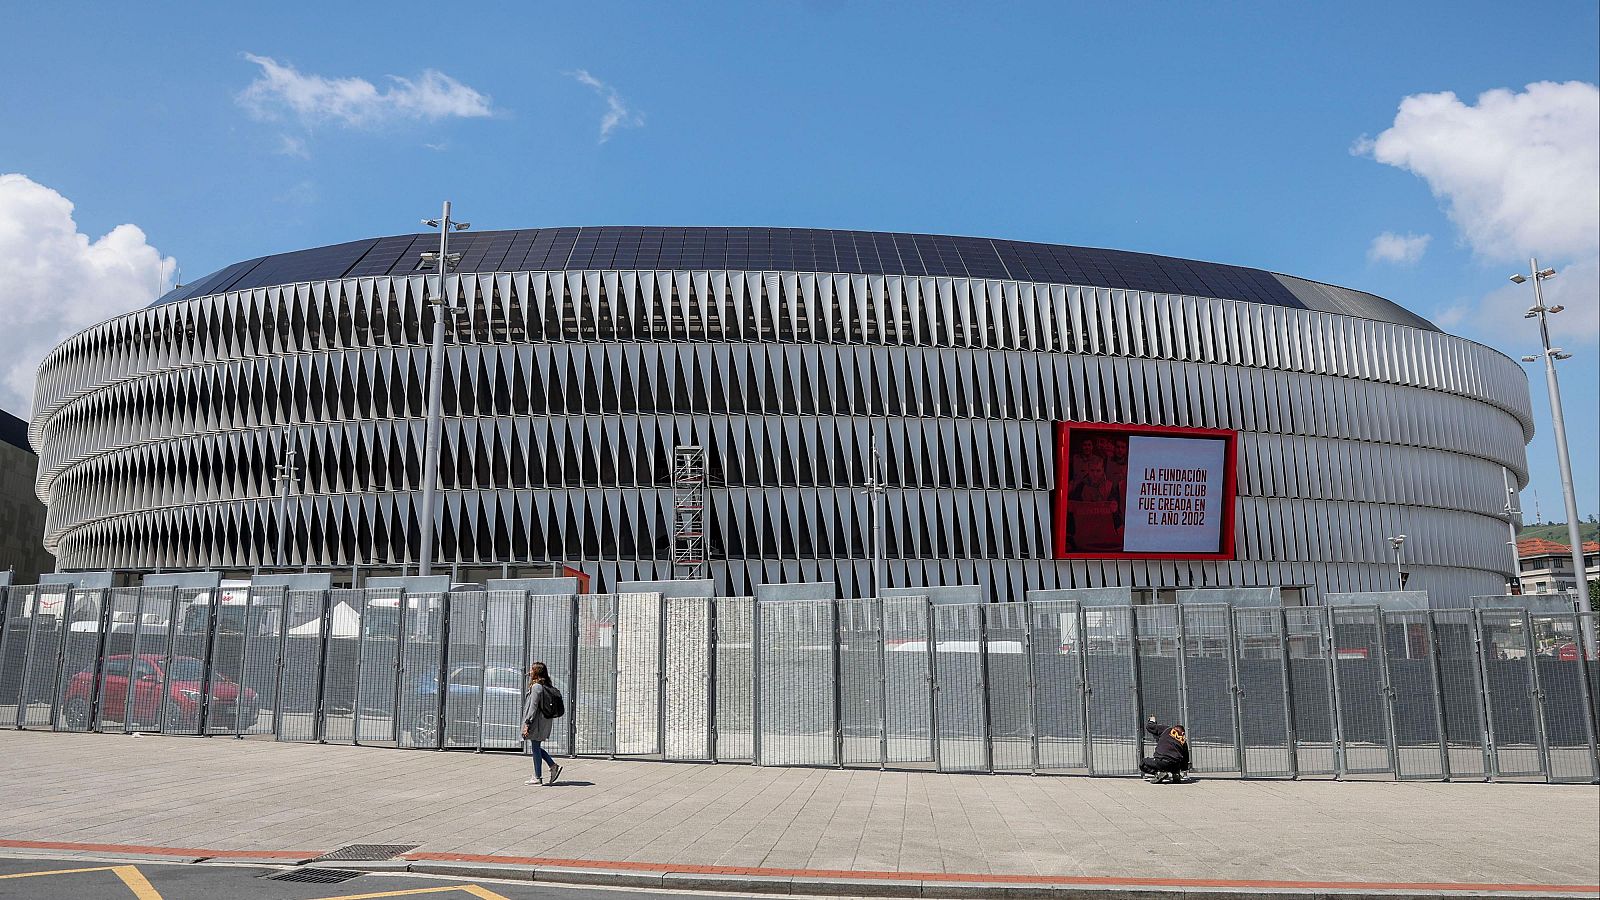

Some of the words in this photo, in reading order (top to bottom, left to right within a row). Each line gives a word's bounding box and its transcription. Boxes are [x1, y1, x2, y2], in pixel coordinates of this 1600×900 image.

[1145, 468, 1155, 481] LA
[1159, 468, 1207, 482] FUNDACIÓN
[1140, 483, 1181, 496] ATHLETIC
[1184, 484, 1206, 497] CLUB
[1139, 498, 1155, 510] FUE
[1158, 498, 1192, 511] CREADA
[1195, 499, 1205, 511] EN
[1148, 513, 1158, 525] EL
[1161, 511, 1179, 525] AÑO
[1181, 512, 1204, 525] 2002
